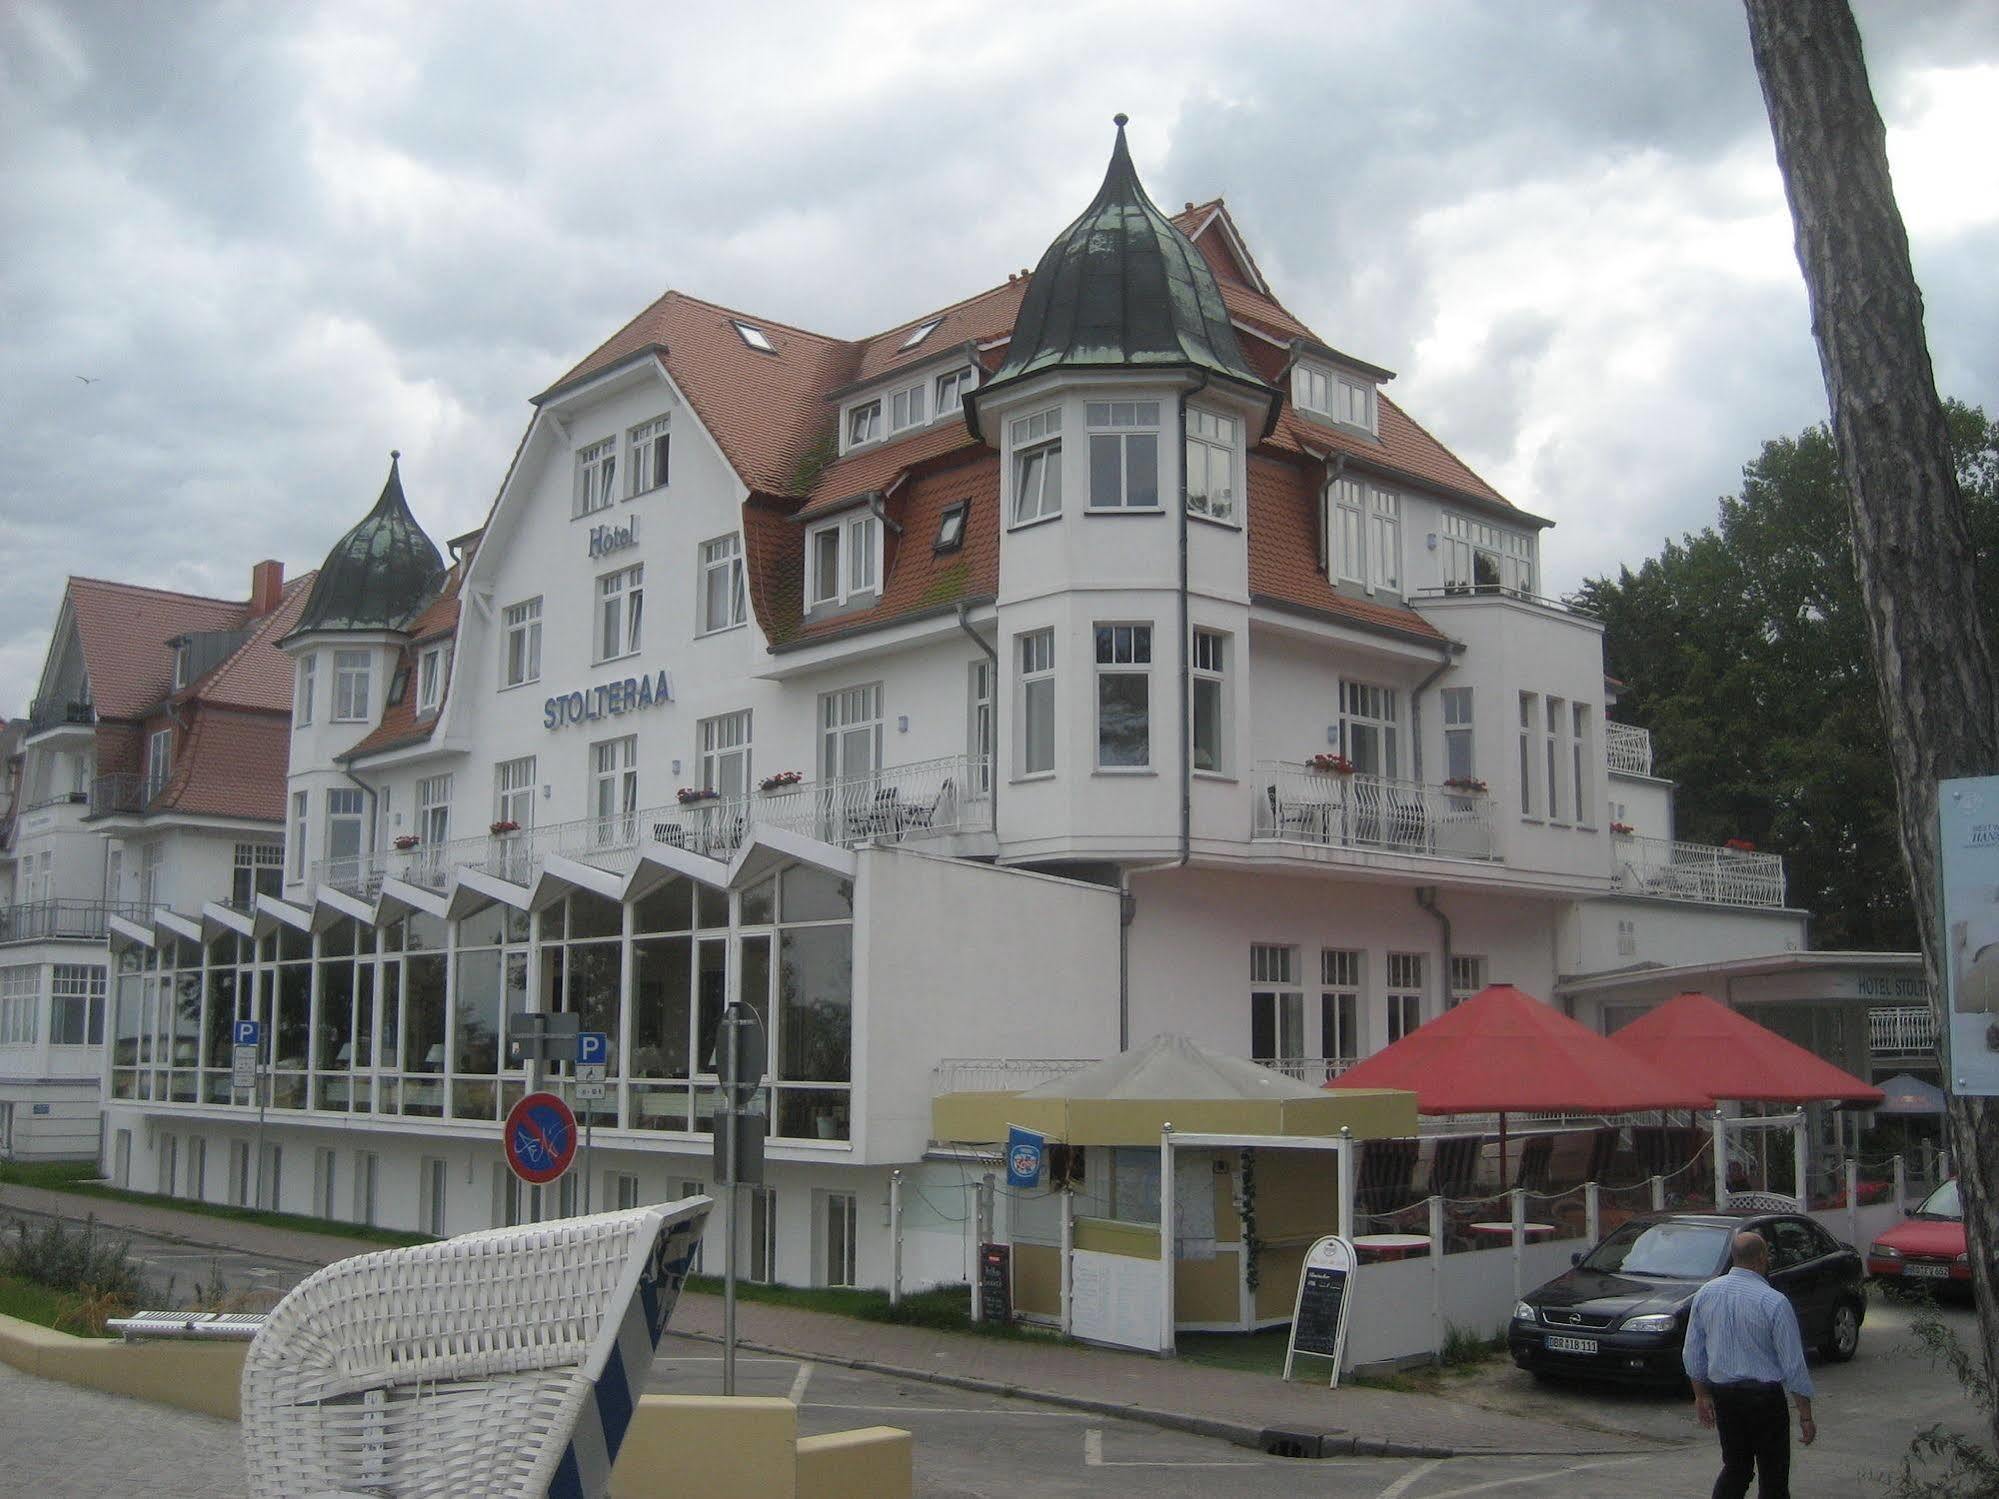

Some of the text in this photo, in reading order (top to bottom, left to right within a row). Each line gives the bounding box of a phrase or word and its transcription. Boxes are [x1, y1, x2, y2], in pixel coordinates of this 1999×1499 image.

[588, 514, 639, 557] Hotel
[544, 670, 672, 729] STOLTERAA
[1858, 976, 1892, 995] HOTEL
[239, 1023, 254, 1042] P
[582, 1036, 600, 1060] P
[1581, 1341, 1596, 1351] 111
